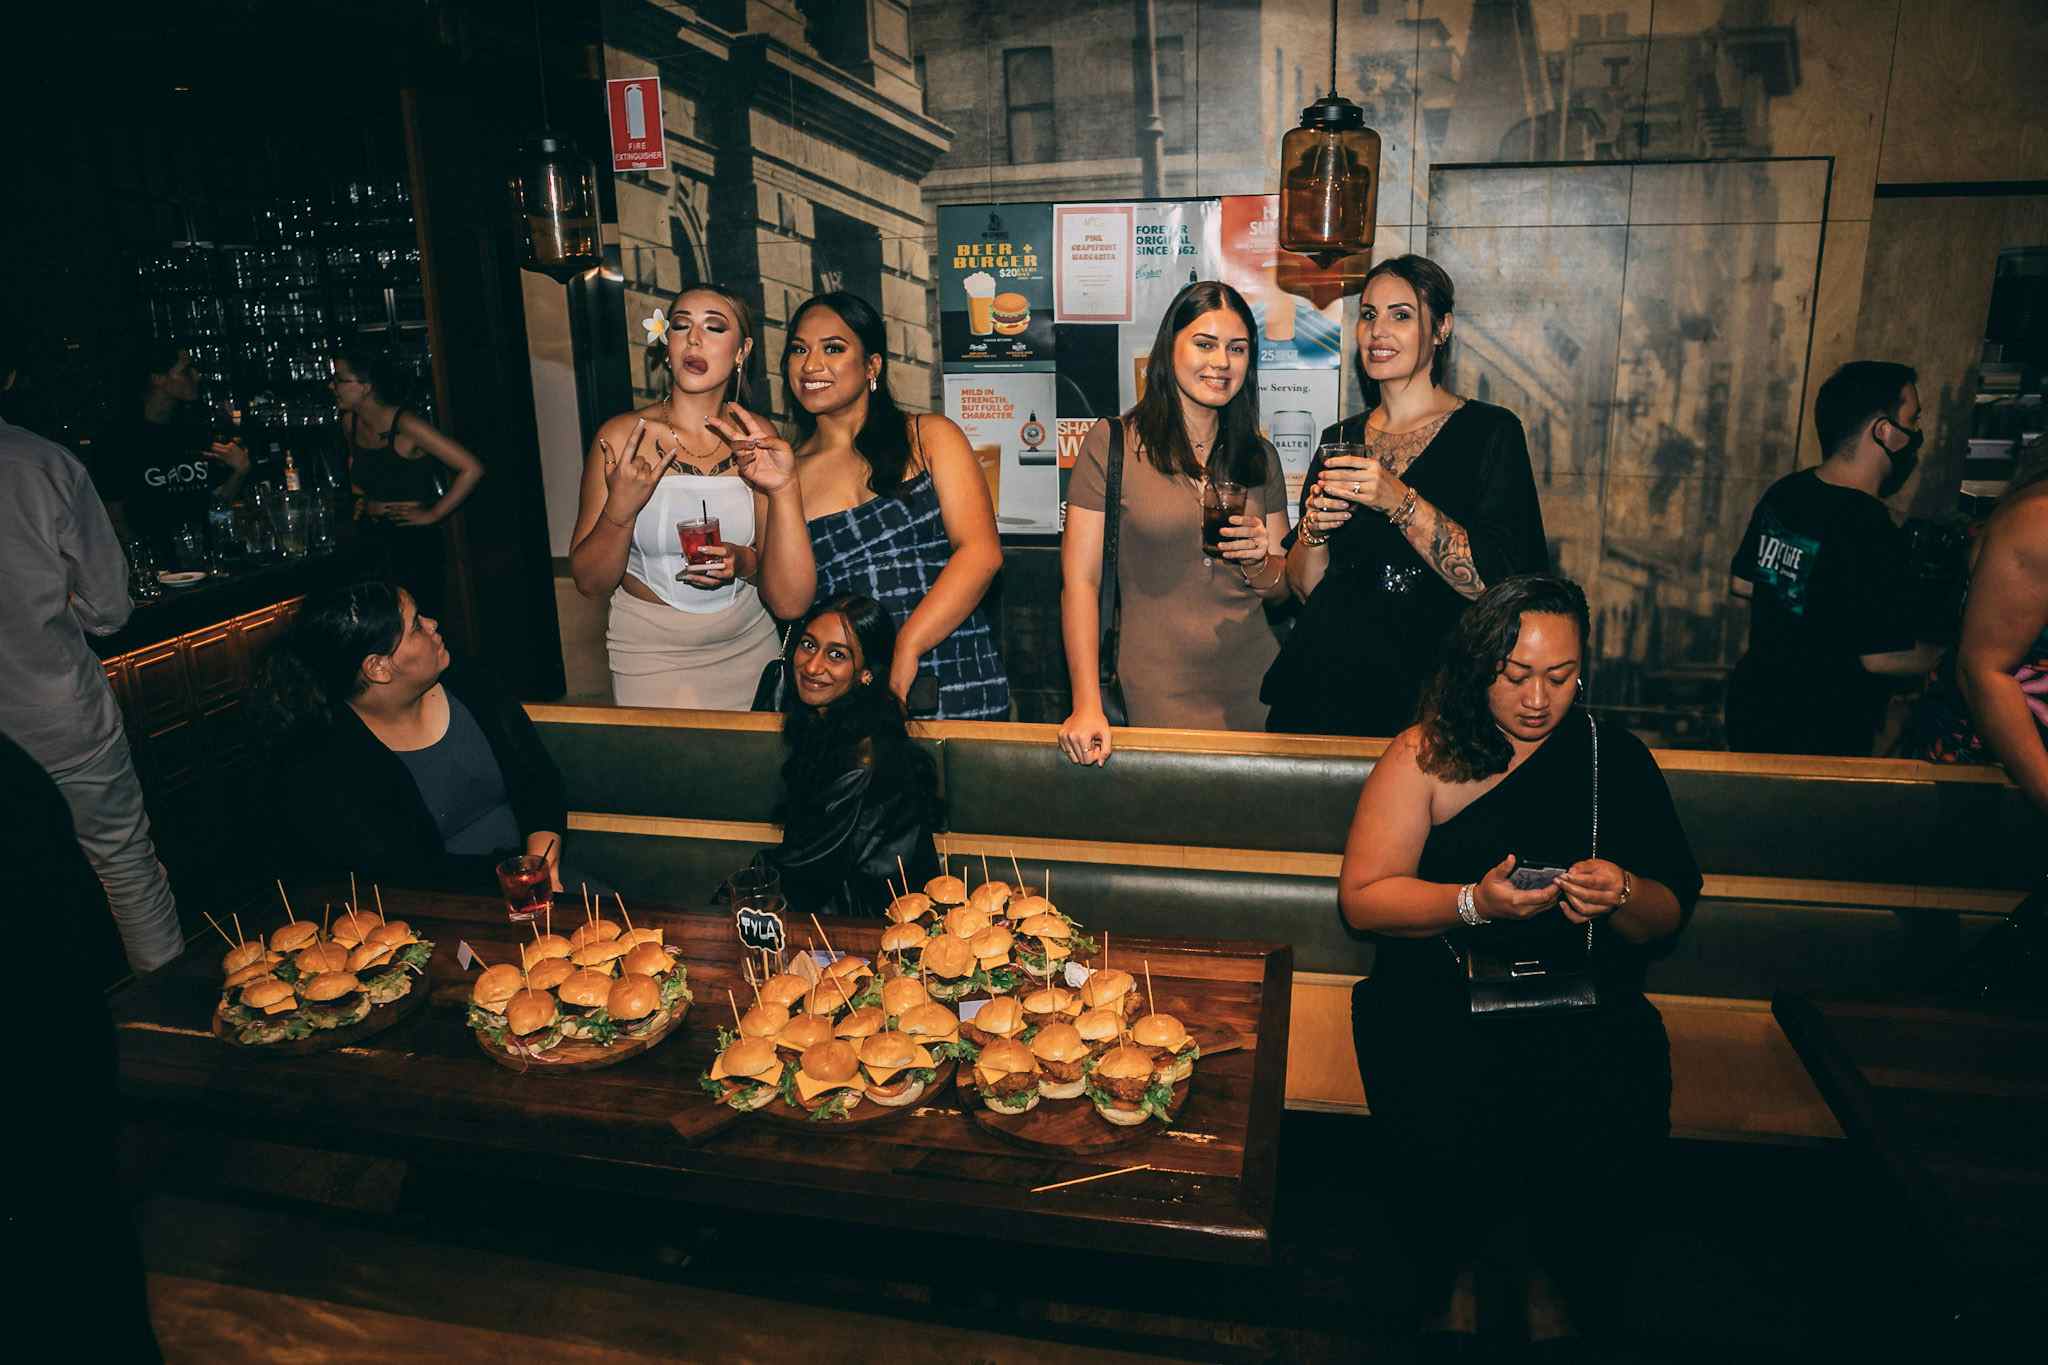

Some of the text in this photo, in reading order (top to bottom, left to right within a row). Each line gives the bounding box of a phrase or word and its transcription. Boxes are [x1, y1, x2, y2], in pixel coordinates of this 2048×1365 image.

[628, 141, 647, 150] FIRE
[615, 151, 663, 161] EXTINGUISHER
[957, 242, 1014, 256] BEER
[1136, 246, 1168, 255] SINCE
[952, 254, 1037, 270] BURGER
[999, 267, 1017, 278] $20
[961, 388, 994, 396] MILD IN
[1271, 383, 1311, 394] Serving.
[1275, 440, 1309, 449] BALTER
[740, 916, 777, 941] TYLA
